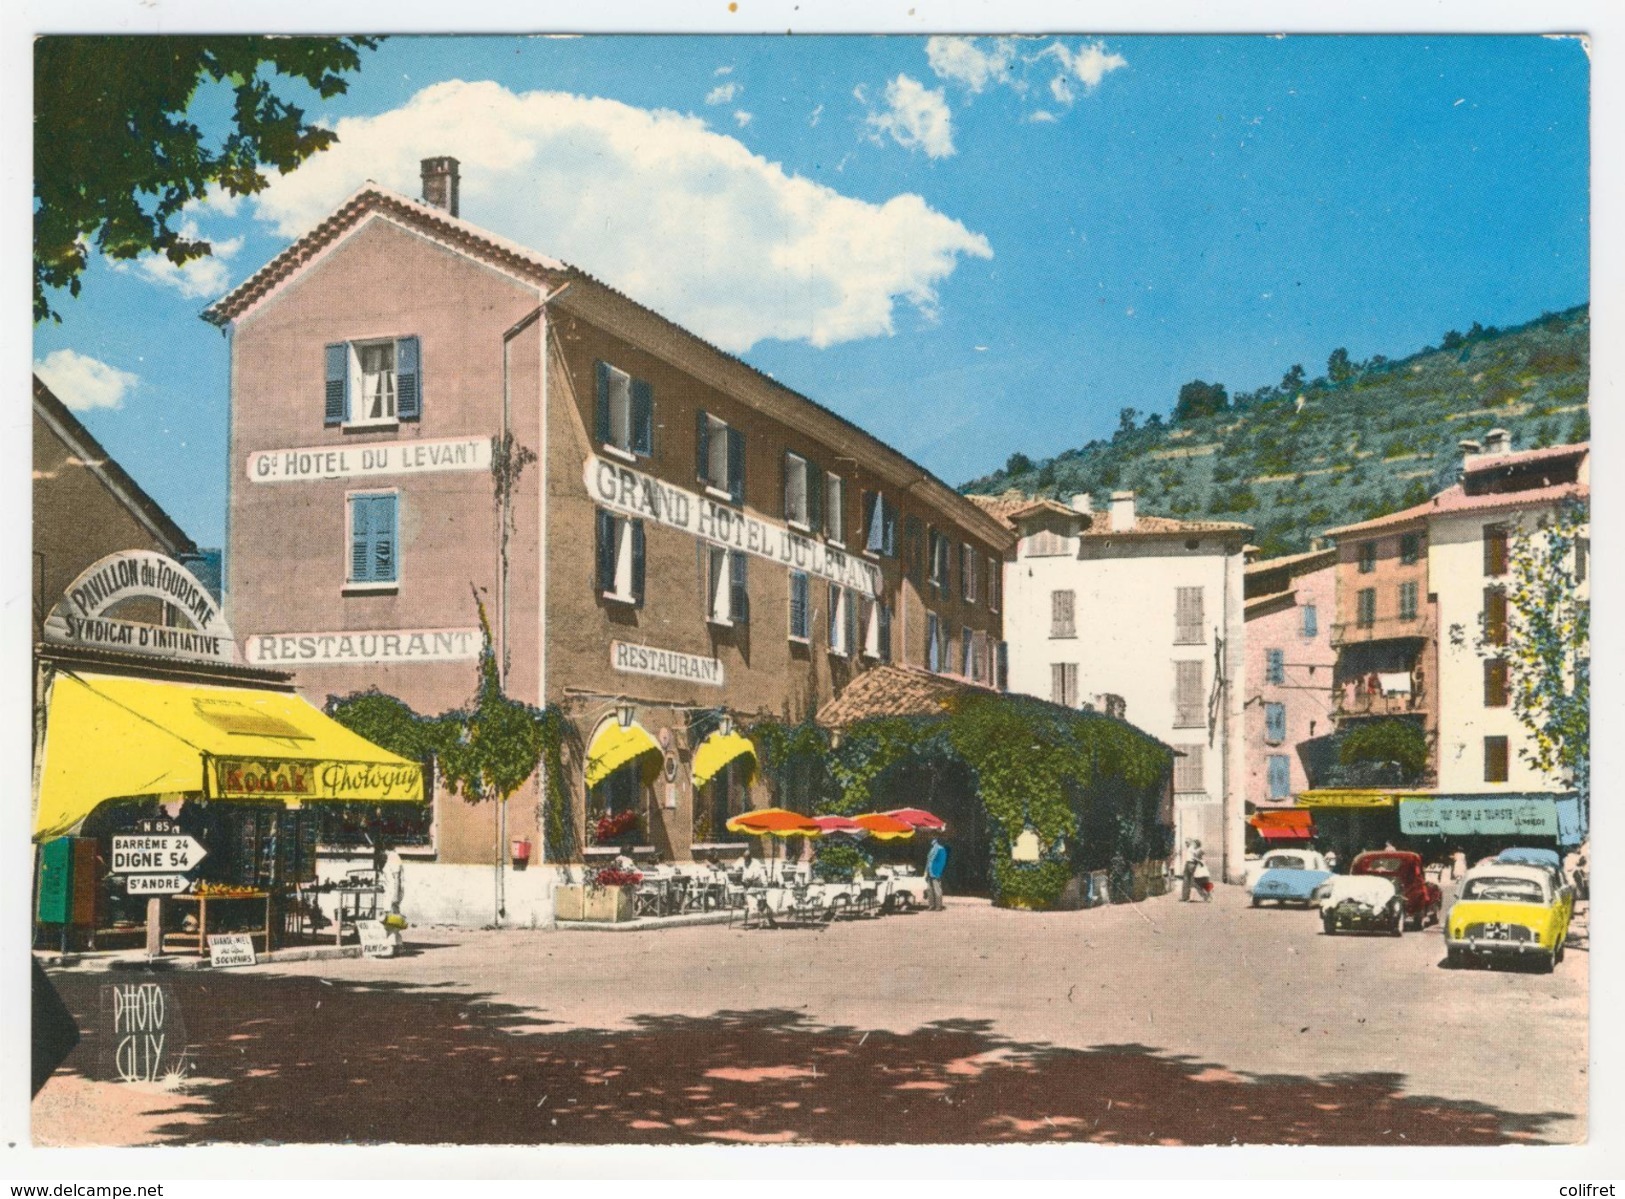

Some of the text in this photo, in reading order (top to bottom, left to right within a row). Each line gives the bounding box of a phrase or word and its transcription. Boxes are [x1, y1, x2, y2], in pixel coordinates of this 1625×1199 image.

[285, 451, 350, 475] HOTEL
[362, 449, 389, 470] DU
[402, 441, 480, 468] LEVANT
[597, 460, 877, 594] GRAND HOTEL DU LEVANT
[70, 558, 214, 630] PAVILLON du TOURISME
[65, 613, 220, 655] SYNDICAT D'INITIATIVE
[257, 632, 474, 661] RESTAURANT
[617, 643, 718, 681] RESTAURANT
[114, 837, 189, 849] BARRÊME 24
[143, 821, 170, 832] N 85
[114, 852, 189, 867] DIGNE 54
